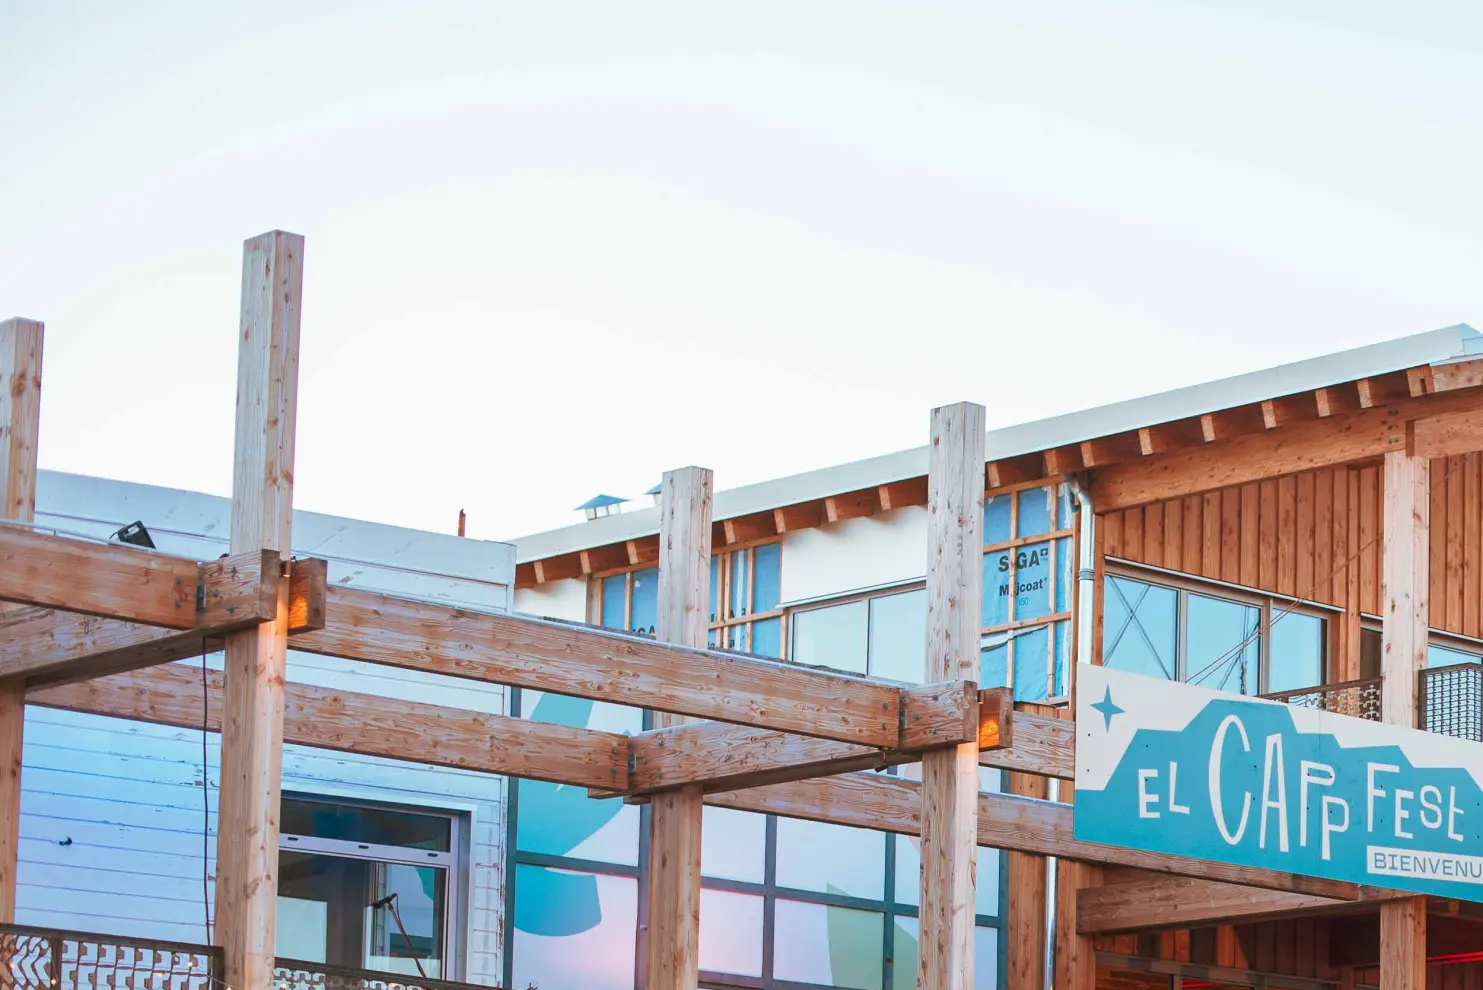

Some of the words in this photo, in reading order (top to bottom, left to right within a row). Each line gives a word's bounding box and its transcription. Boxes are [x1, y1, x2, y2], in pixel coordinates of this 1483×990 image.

[999, 550, 1040, 572] SGA
[1137, 761, 1190, 819] EL
[1208, 714, 1350, 861] CAPP
